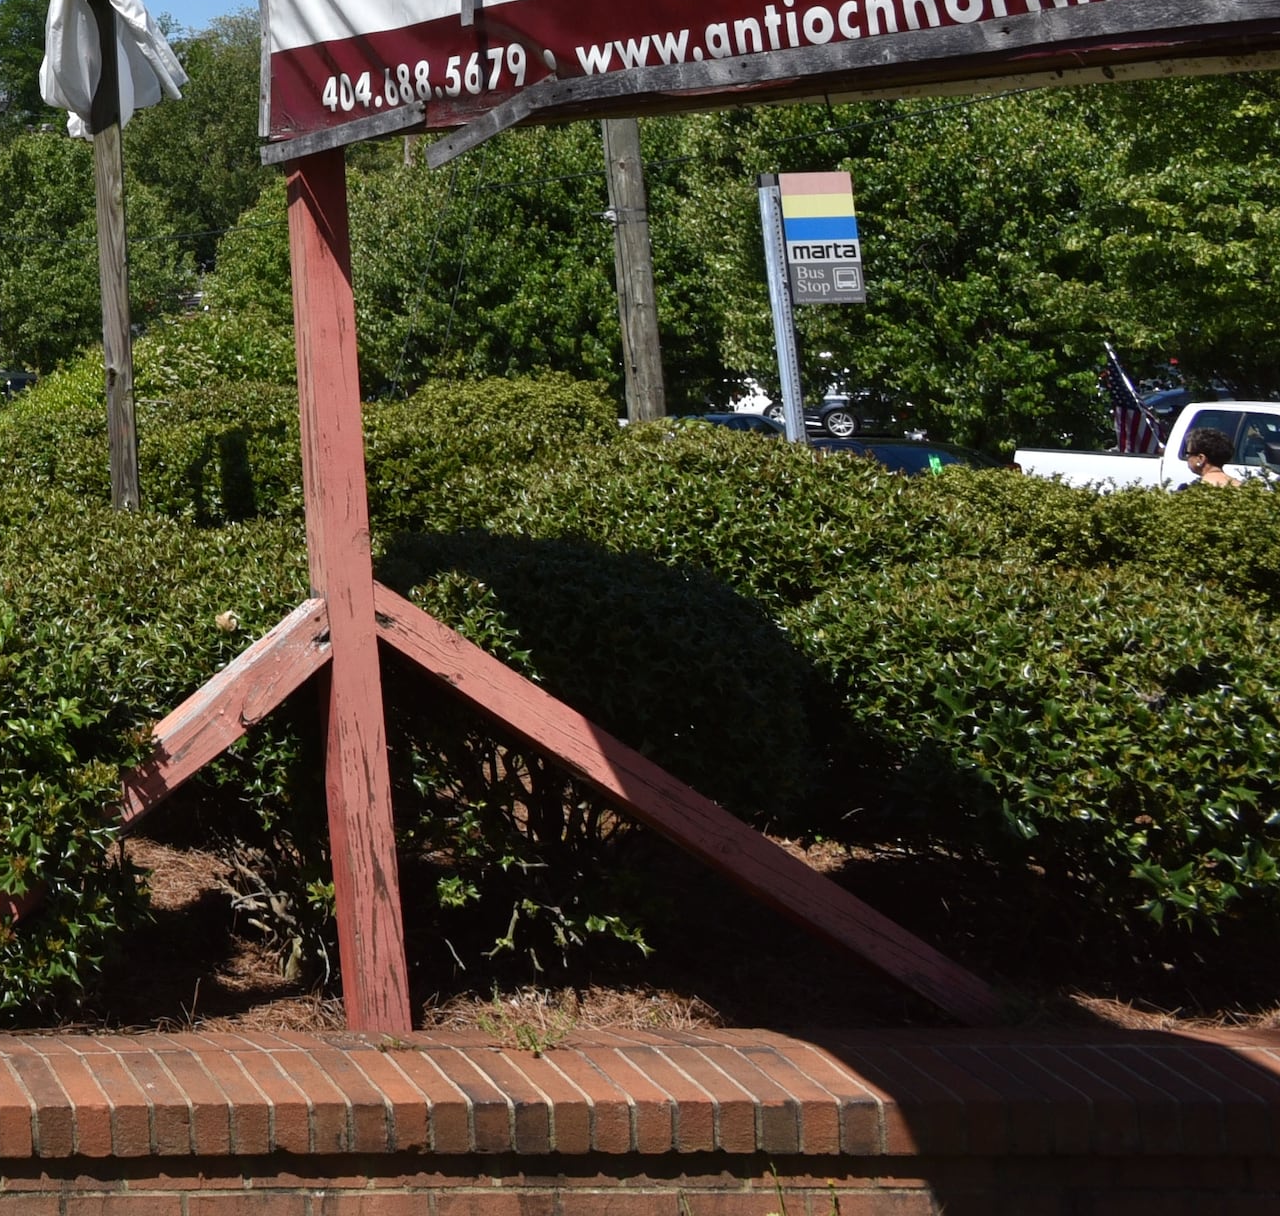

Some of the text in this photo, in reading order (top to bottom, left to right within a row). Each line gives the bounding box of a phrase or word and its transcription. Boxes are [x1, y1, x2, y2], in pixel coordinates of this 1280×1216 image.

[322, 43, 527, 113] 404.688.5679
[793, 243, 857, 259] marta
[796, 266, 825, 279] Bus
[797, 280, 831, 295] Stop
